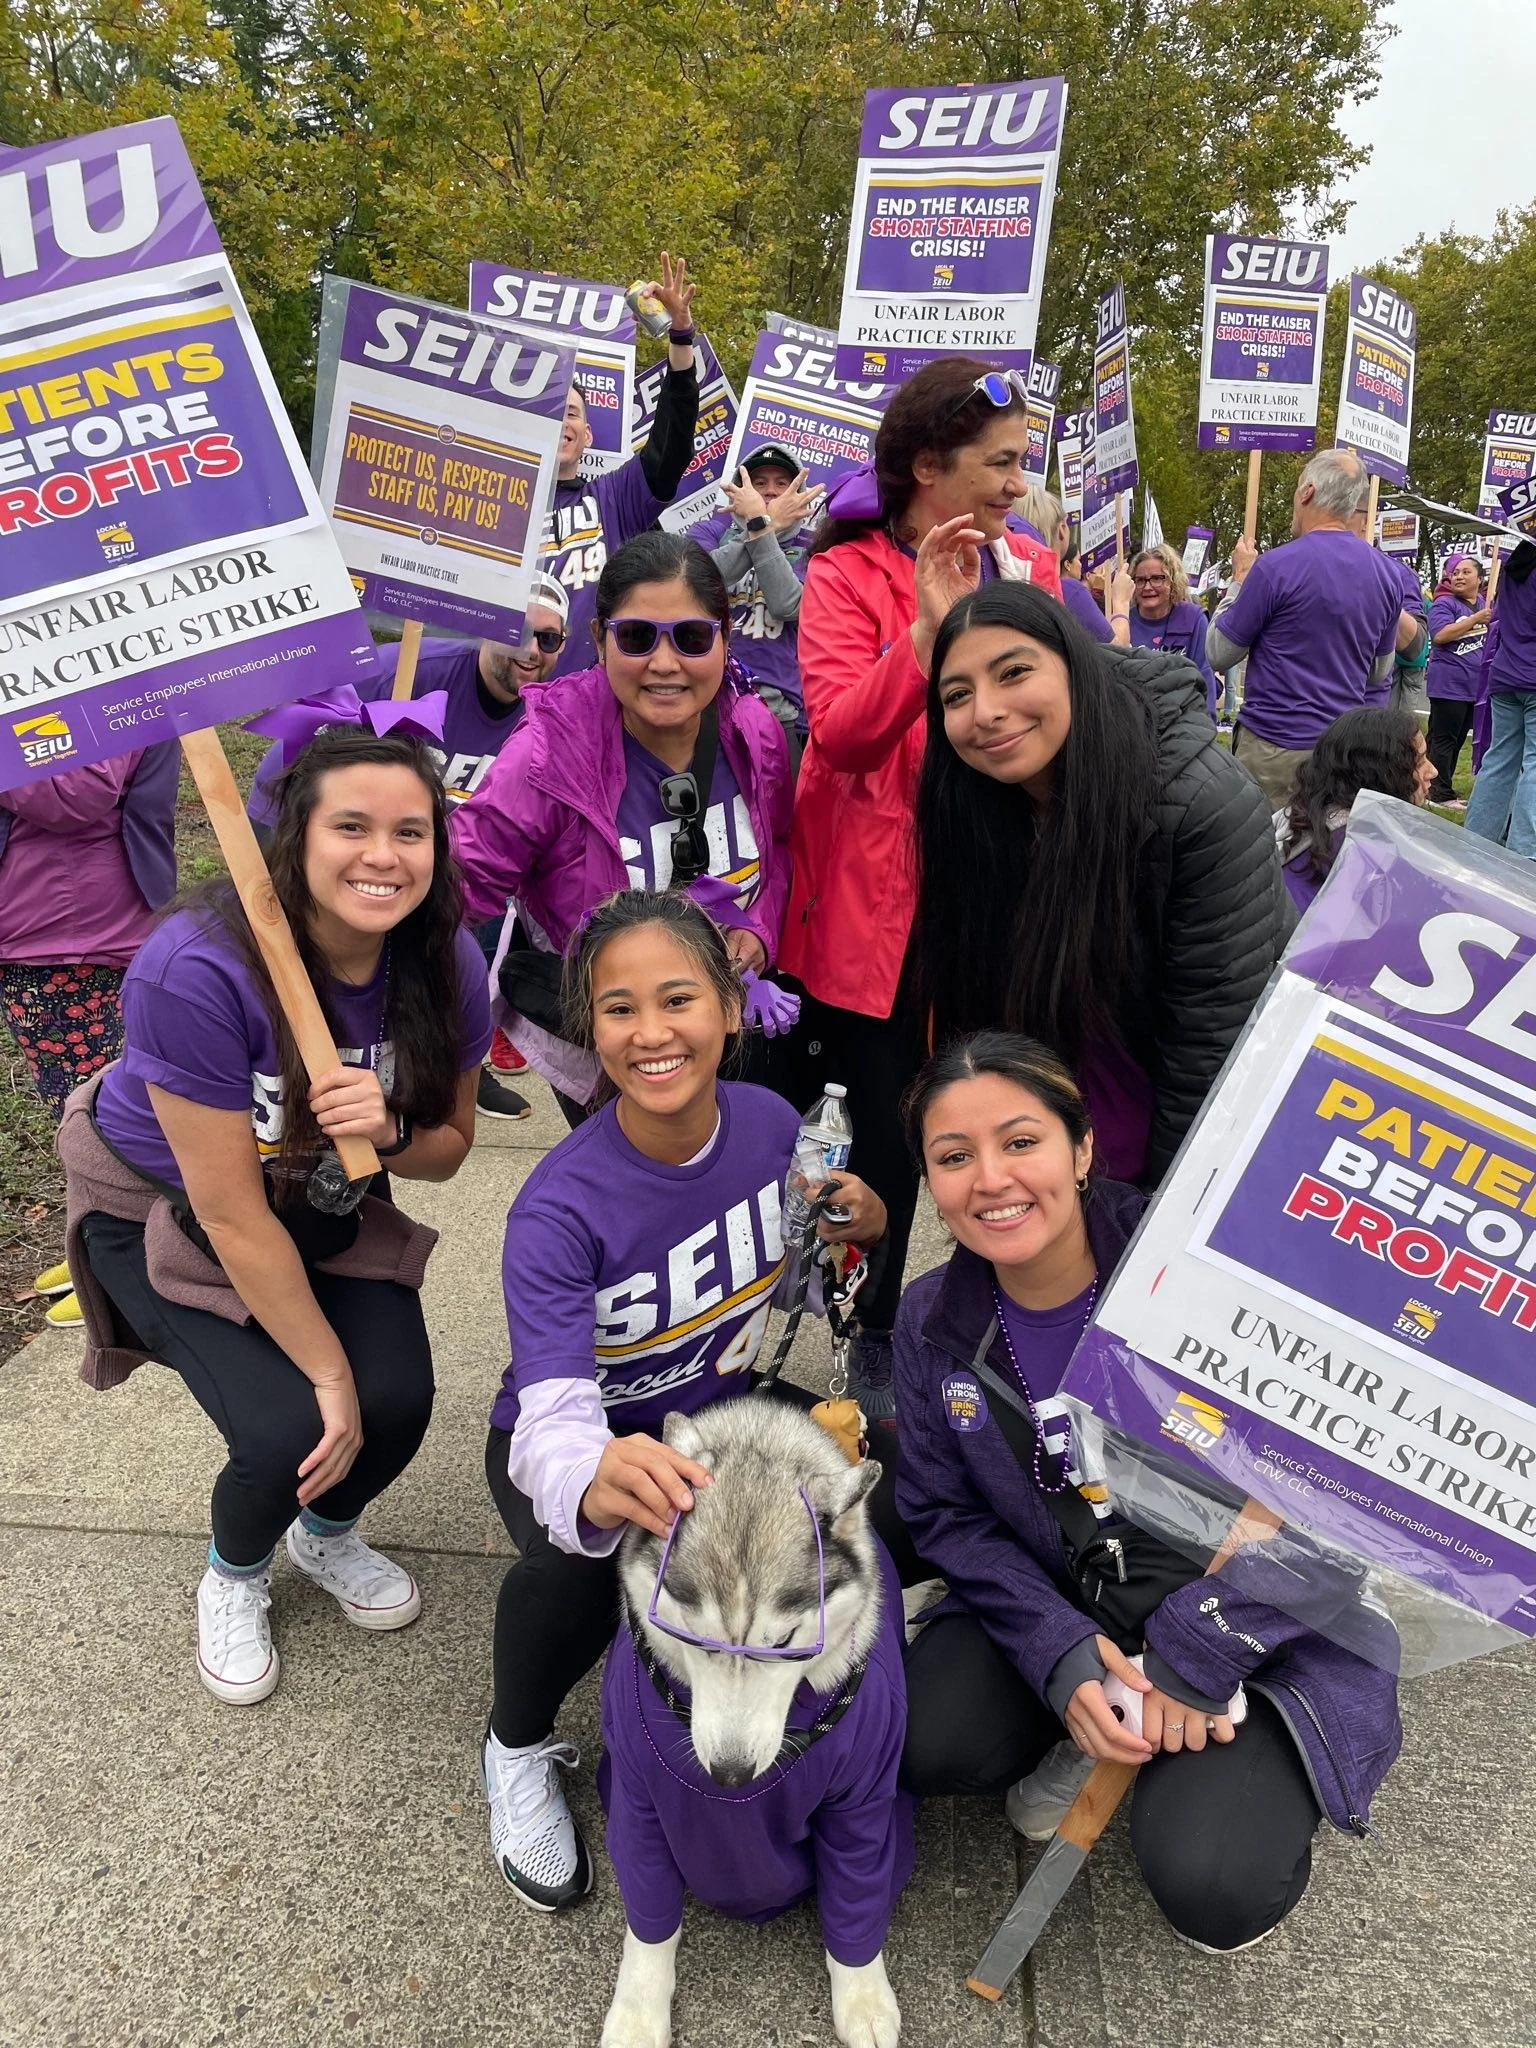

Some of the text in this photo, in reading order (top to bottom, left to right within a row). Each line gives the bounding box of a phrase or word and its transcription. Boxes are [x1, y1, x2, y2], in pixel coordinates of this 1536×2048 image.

[879, 88, 1049, 149] SEIU
[877, 196, 1029, 215] END THE KAISER
[869, 217, 1031, 238] SHORT STAFFING
[910, 240, 985, 258] CRISIS!!
[1221, 242, 1321, 285] SEIU
[487, 274, 625, 332] SEIU
[874, 305, 1005, 321] UNFAIR LABOR
[1357, 284, 1413, 338] SEIU
[1220, 312, 1311, 330] END THE KAISER
[857, 327, 1016, 345] PRACTICE STRIKE
[1216, 326, 1312, 346] SHORT STAFFING
[363, 307, 559, 399] SEIU
[1241, 343, 1286, 358] CRISIS!!
[1356, 341, 1408, 379] PATIENTS
[862, 364, 885, 372] SEIU
[1359, 358, 1403, 391] BEFORE
[1099, 371, 1124, 397] BEFORE
[1356, 371, 1404, 406] PROFITS
[1221, 392, 1298, 406] UNFAIR LABOR
[756, 407, 870, 449] END THE KAISER
[1212, 409, 1306, 423] PRACTICE STRIKE
[1352, 416, 1400, 443] UNFAIR LABOR
[1493, 413, 1536, 436] SEIU
[749, 420, 869, 464] SHORT STAFFING
[1215, 434, 1229, 442] SEIU
[1345, 429, 1403, 460] PRACTICE STRIKE
[1492, 449, 1531, 462] PATIENTS
[1493, 458, 1528, 470] BEFORE
[346, 432, 529, 511] PROTECT US, RESPECT US,
[1491, 466, 1526, 479] PROFITS
[368, 470, 500, 530] STAFF US, PAY US!
[680, 492, 717, 520] UNFAIR
[96, 521, 128, 534] LOCAL 49
[104, 541, 136, 560] SEIU
[137, 549, 276, 609] LABOR
[380, 553, 460, 584] UNFAIR LABOR PRACTICE STRIKE
[179, 584, 320, 648] STRIKE
[384, 586, 496, 621] Service Employees International Union
[102, 644, 316, 716] Service Employees International Union
[141, 705, 165, 720] CLC
[24, 734, 73, 763] SEIU
[29, 748, 78, 767] Stronger Together
[1315, 1078, 1536, 1217] PATIE
[1318, 1136, 1536, 1272] BEFO
[1408, 1298, 1442, 1317] LOCAL 49
[1394, 1318, 1432, 1339] SEIU
[947, 1389, 979, 1400] STRONG
[950, 1382, 976, 1392] UNION
[1171, 1333, 1386, 1460] PRACTICE
[1229, 1305, 1536, 1479] UNFAIR LABOR
[951, 1401, 976, 1411] BRING
[1159, 1428, 1185, 1445] Stronger
[1161, 1414, 1218, 1448] SEIU
[1253, 1460, 1315, 1498] CTW, CLC
[1260, 1444, 1494, 1568] Service Employees International Union
[1211, 1611, 1267, 1654] FREE UNTRY
